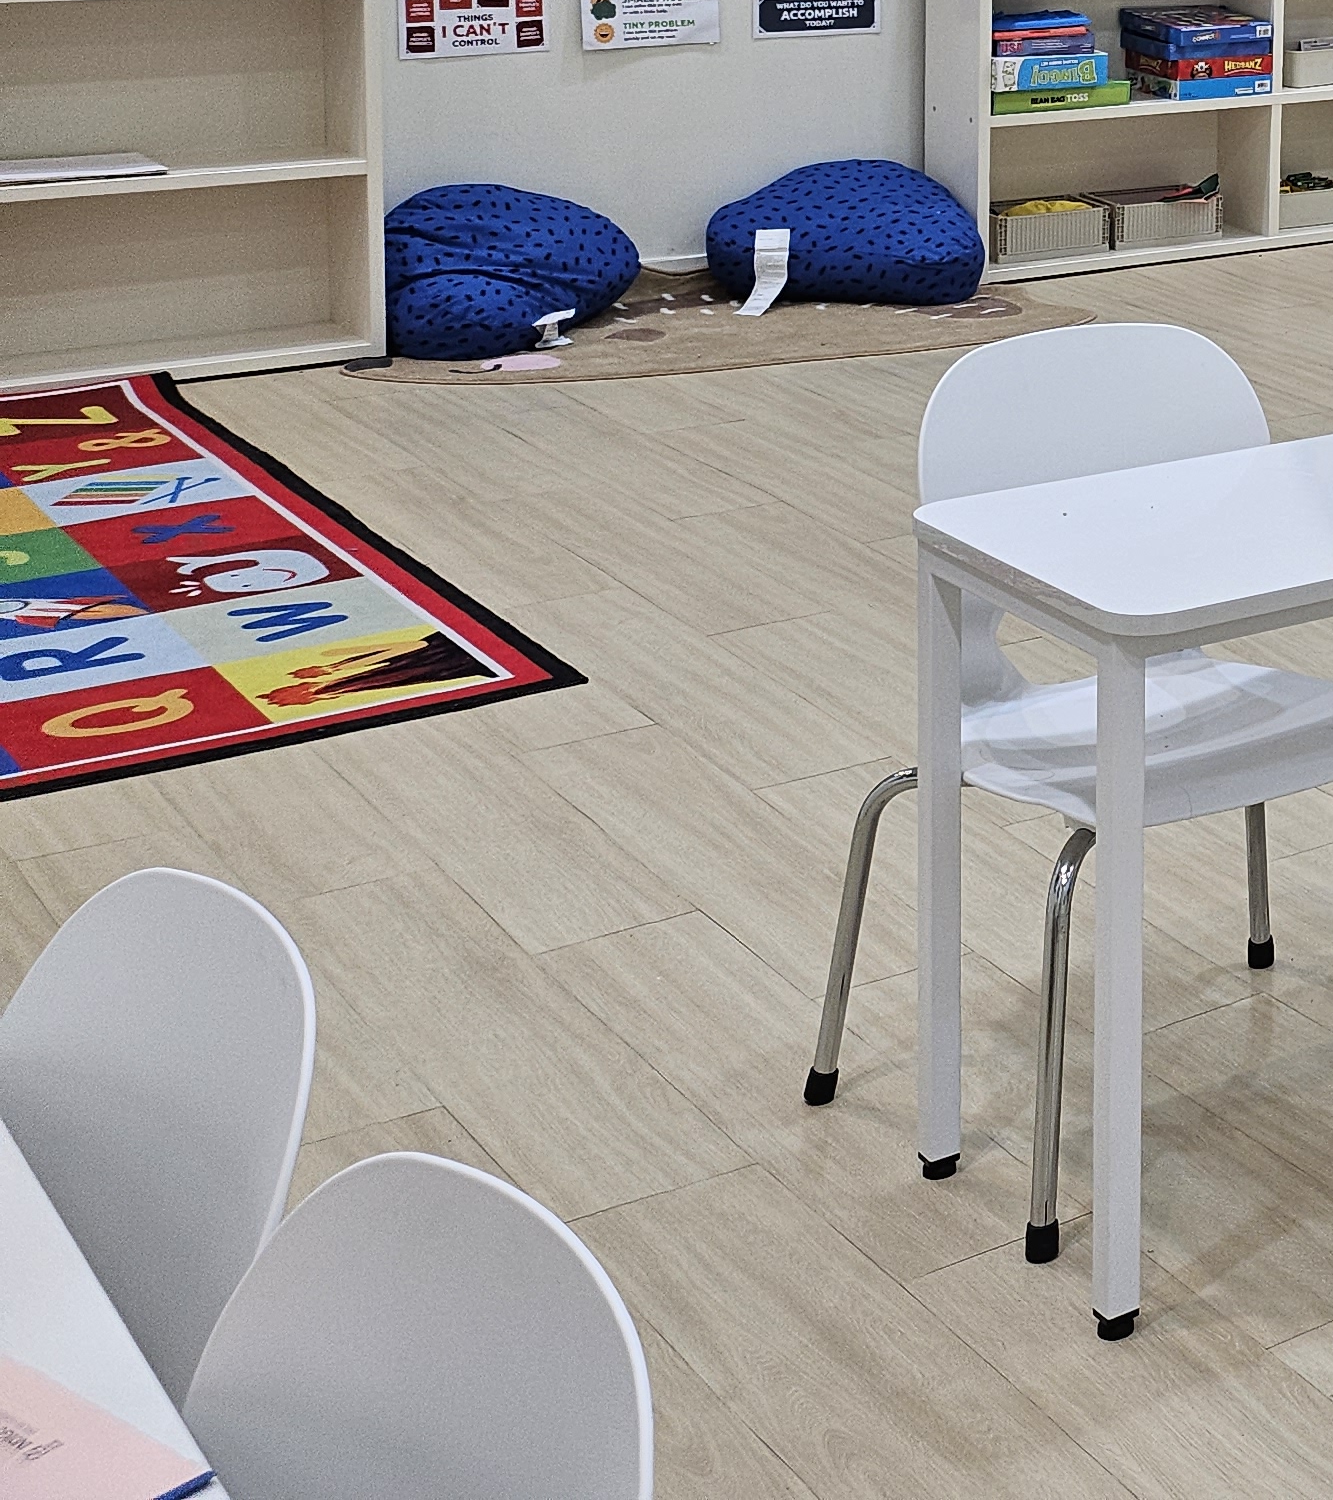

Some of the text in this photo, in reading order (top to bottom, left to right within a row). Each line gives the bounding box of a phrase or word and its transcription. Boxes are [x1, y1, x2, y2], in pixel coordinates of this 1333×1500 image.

[775, 2, 799, 10] WHAT
[800, 1, 812, 9] DO
[457, 14, 493, 22] THINGS
[780, 7, 858, 21] ACCOMPLISH
[441, 26, 447, 38] I
[452, 22, 510, 37] CAN'T
[623, 20, 695, 30] TINY PROBLEM
[451, 38, 500, 47] CONTROL
[1030, 97, 1050, 105] BEAN
[1066, 93, 1089, 102] TOSS
[11, 458, 112, 482] Y
[131, 514, 235, 544] X
[227, 602, 349, 643] W
[0, 636, 146, 682] R
[41, 688, 195, 738] Q
